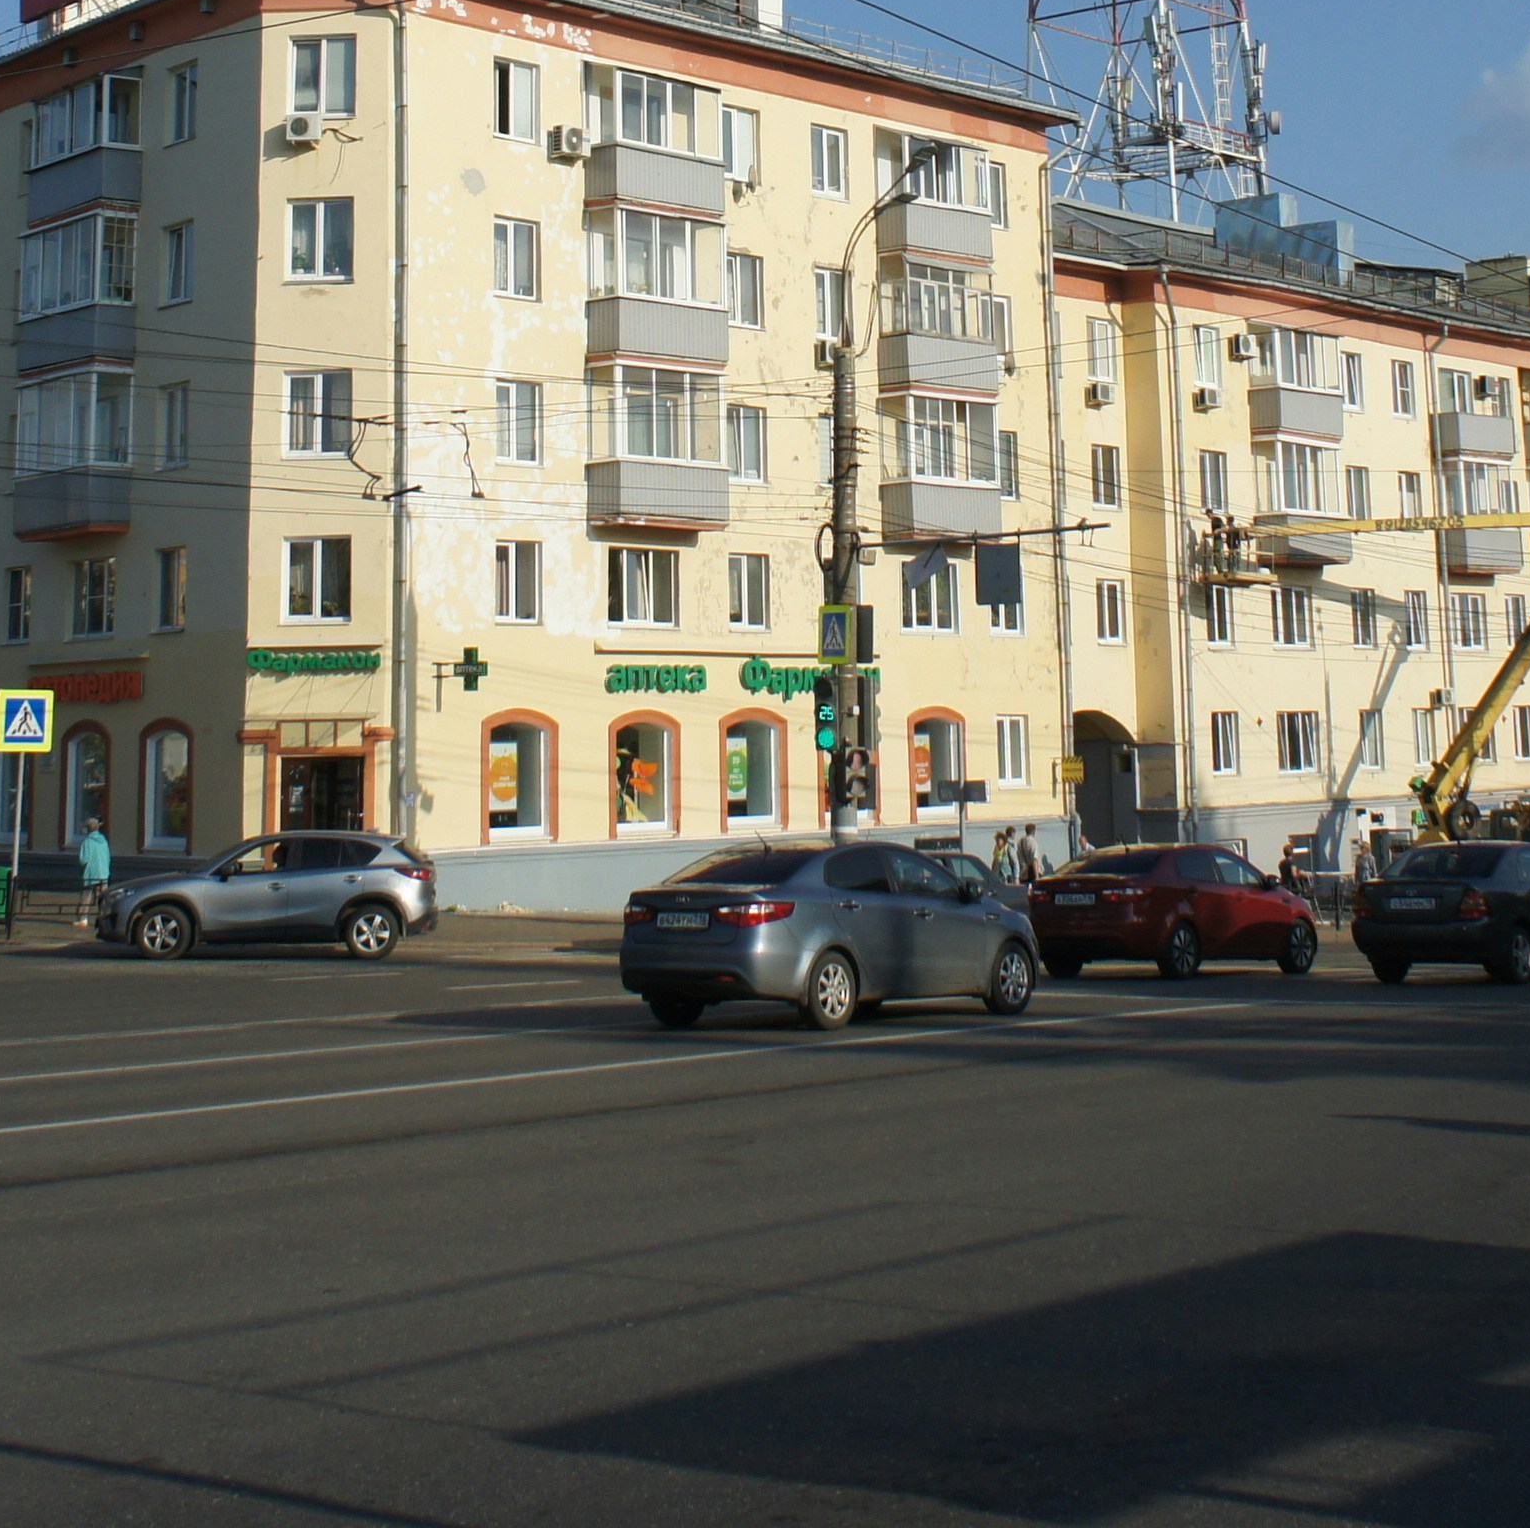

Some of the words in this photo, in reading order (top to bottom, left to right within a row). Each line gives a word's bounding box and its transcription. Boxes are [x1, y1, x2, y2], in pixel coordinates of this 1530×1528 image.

[247, 648, 382, 675] Фармакон
[604, 663, 707, 694] аптека
[739, 655, 881, 703] Фармн
[819, 705, 834, 721] 25
